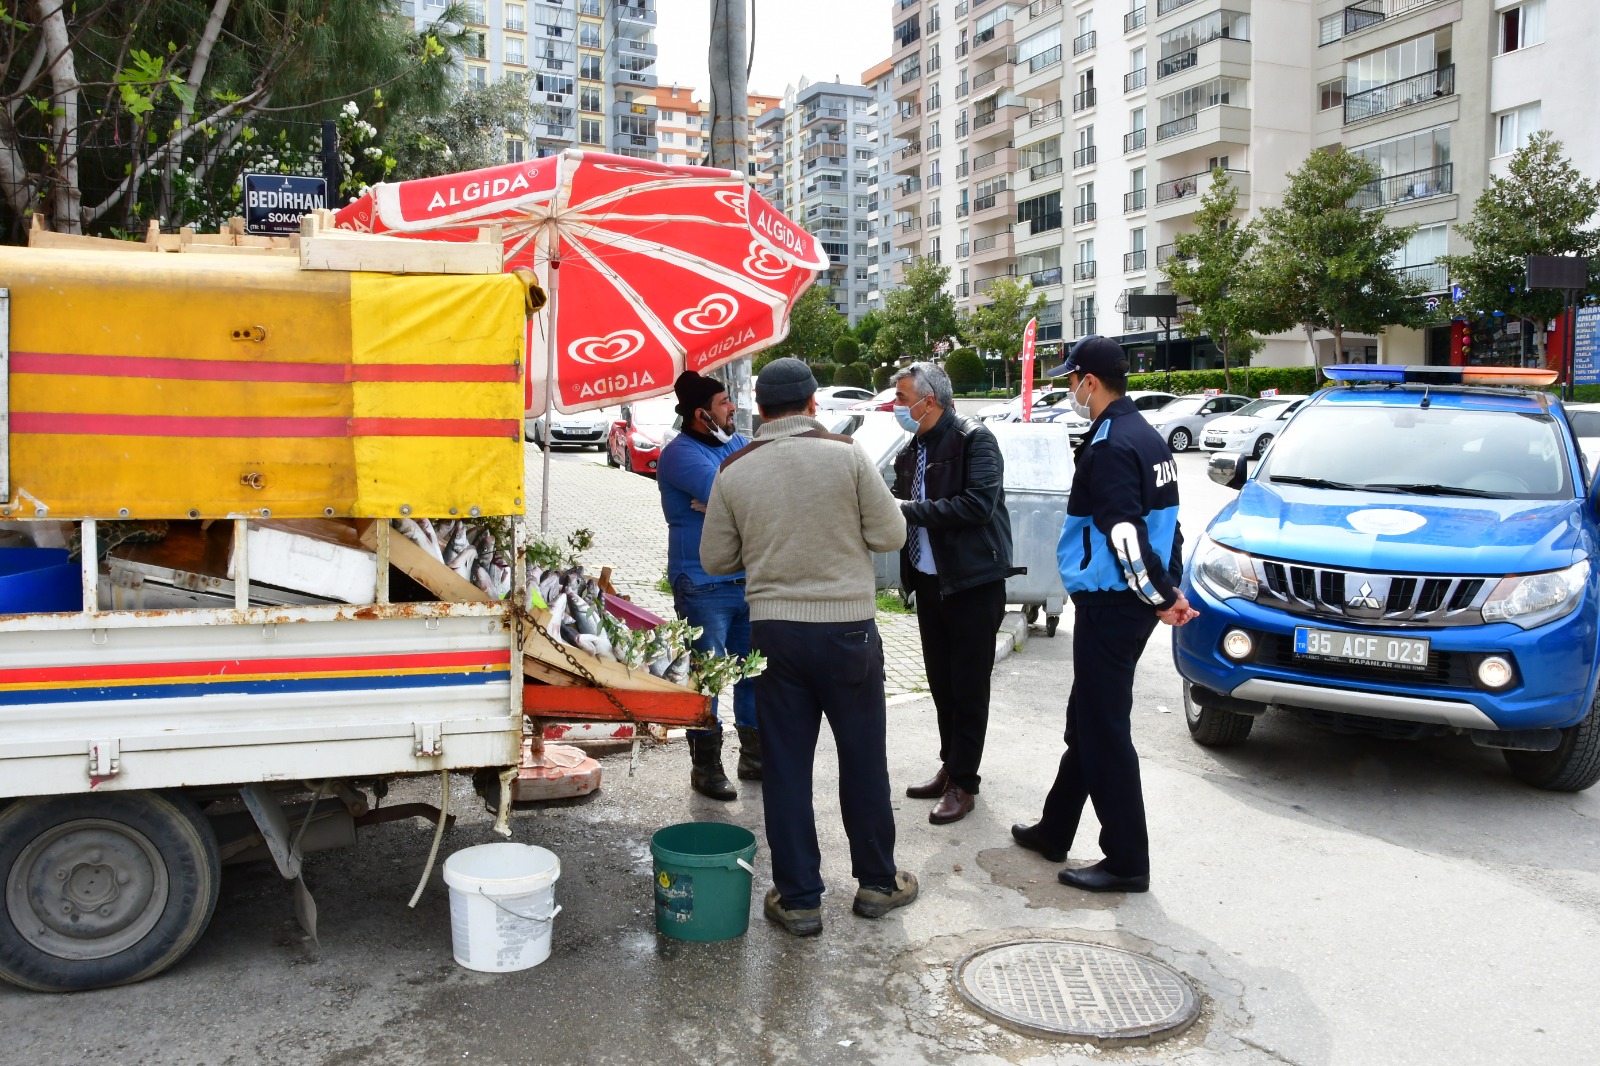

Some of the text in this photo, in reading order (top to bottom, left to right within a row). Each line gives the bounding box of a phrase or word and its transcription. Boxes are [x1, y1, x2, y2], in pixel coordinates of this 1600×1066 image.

[248, 188, 324, 210] BEDİRHAN
[268, 211, 302, 223] SOKAĞ
[1308, 633, 1425, 664] 35 ACF 023
[1348, 658, 1393, 669] KAPANLAR
